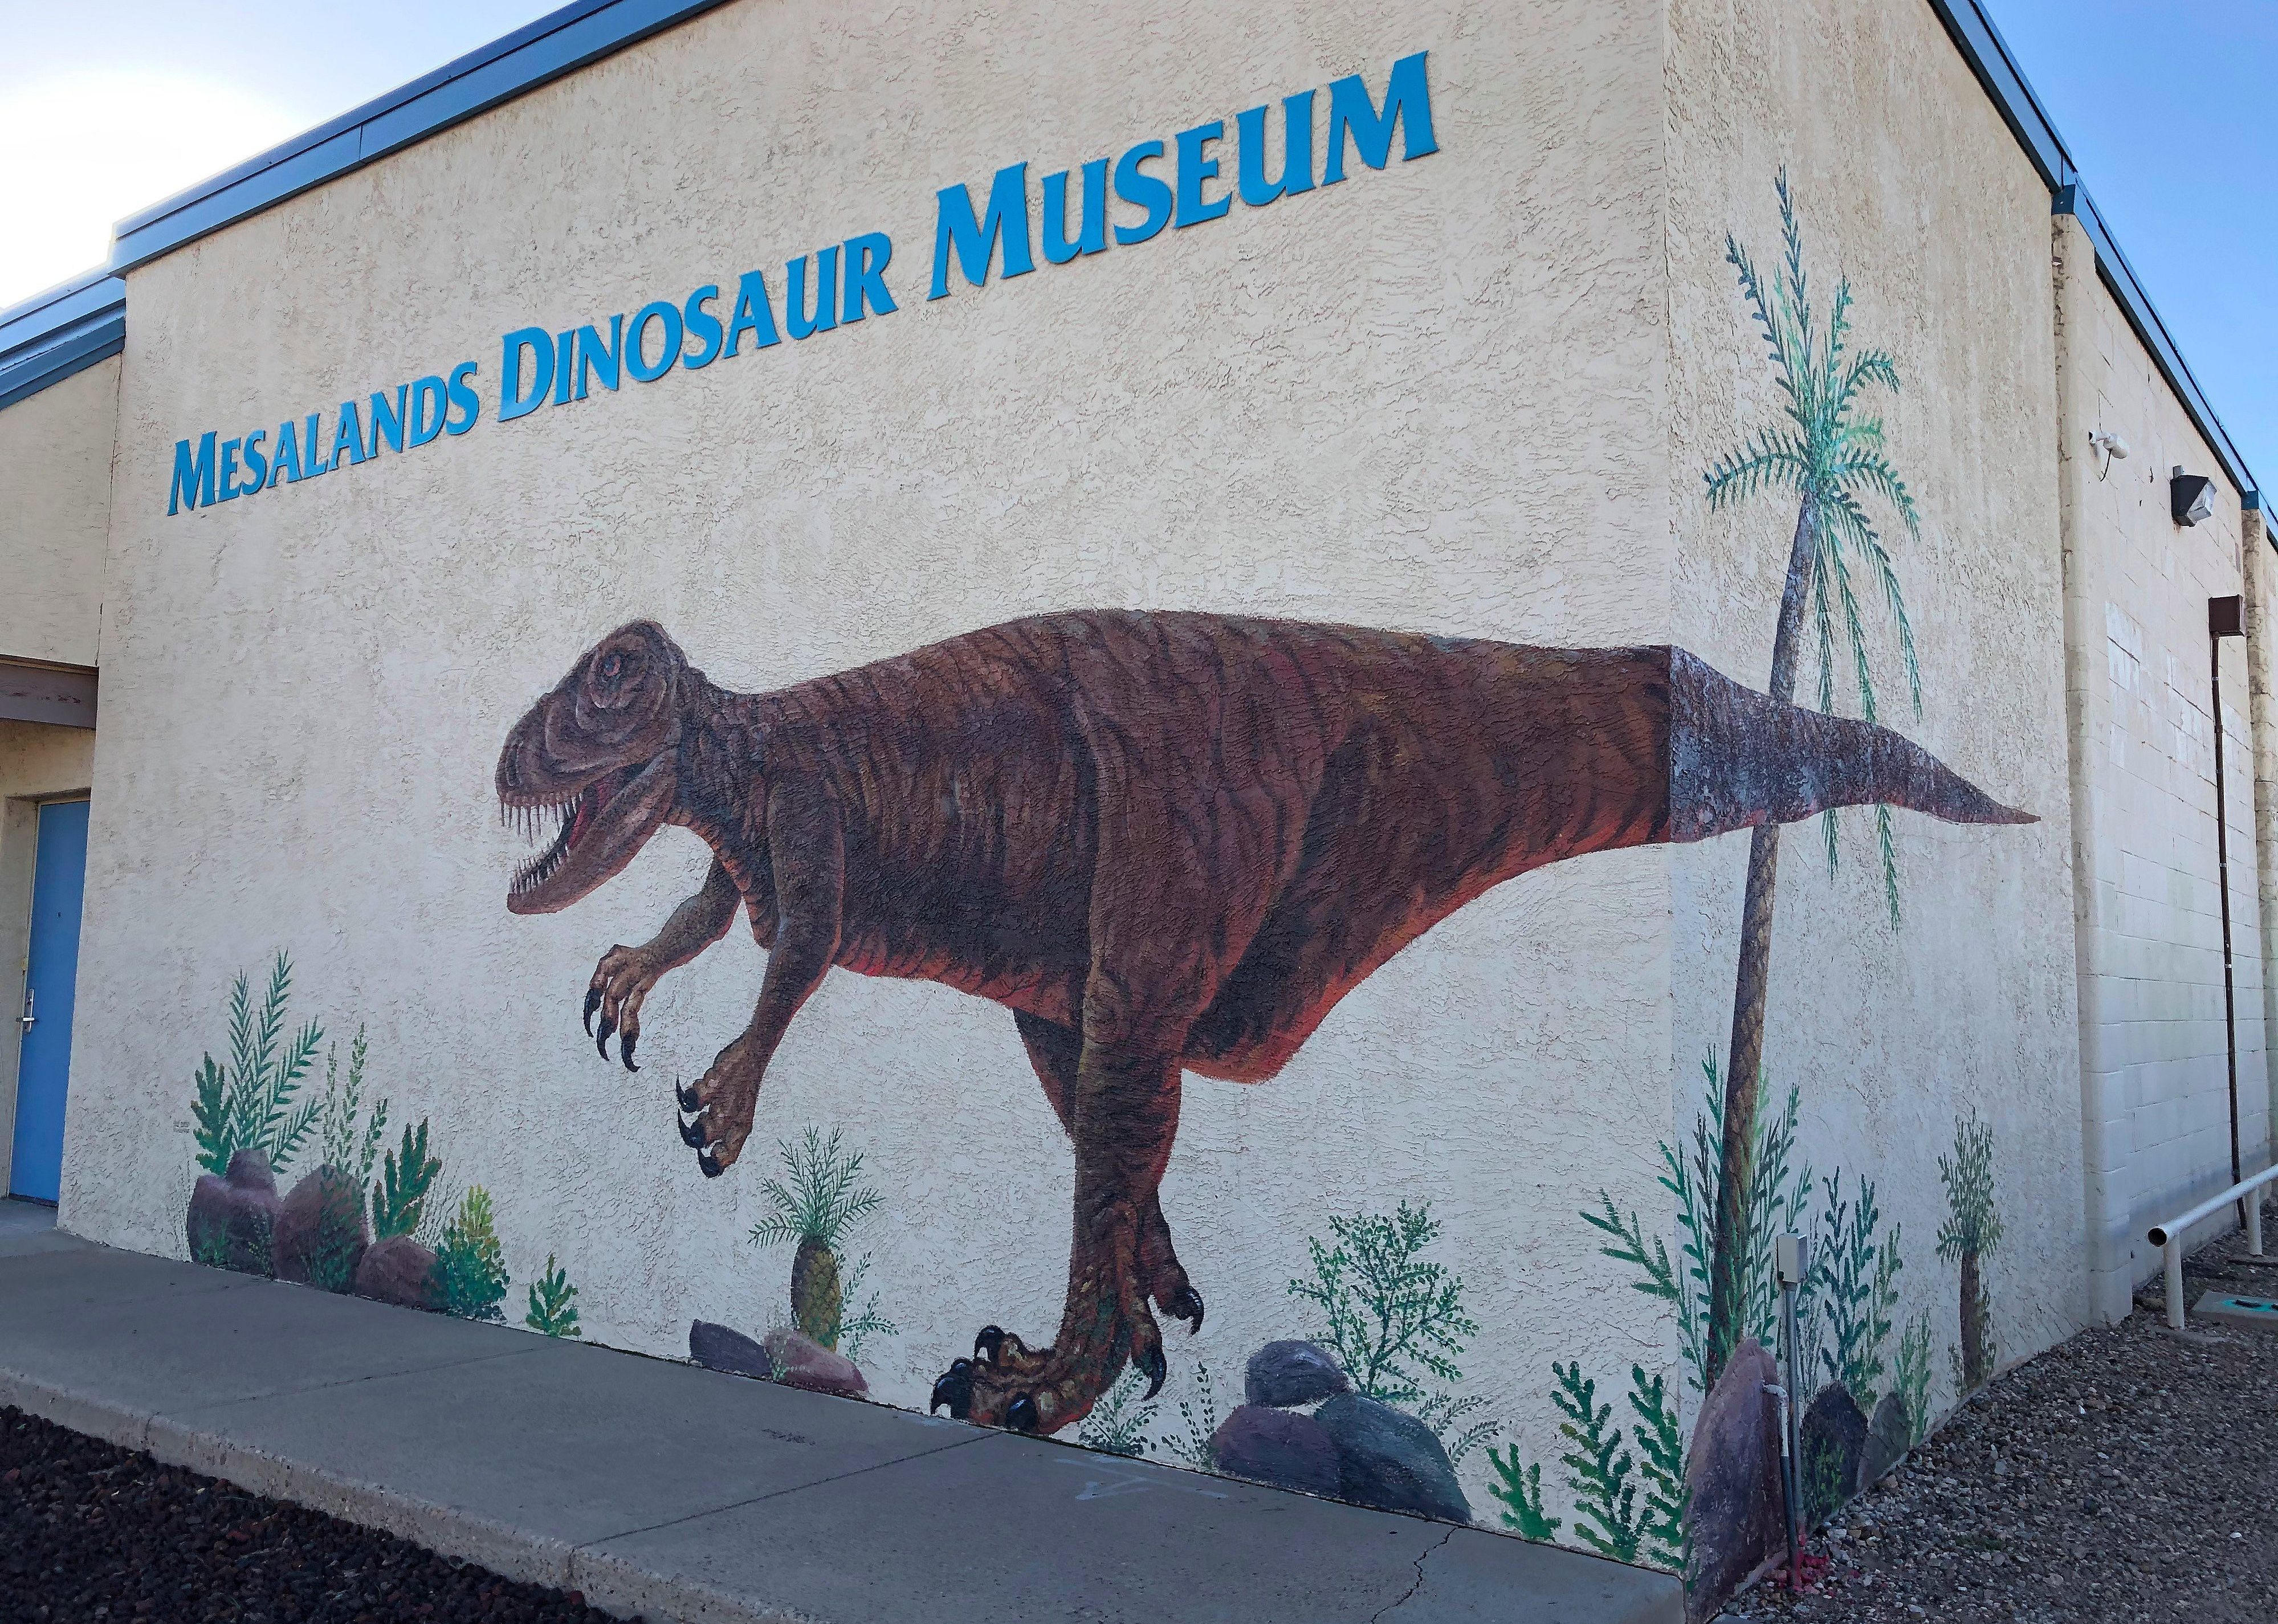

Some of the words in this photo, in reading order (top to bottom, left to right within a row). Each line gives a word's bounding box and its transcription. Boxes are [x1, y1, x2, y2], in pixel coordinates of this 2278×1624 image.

[167, 361, 480, 516] MESALANDS
[498, 231, 898, 422] DINOSAUR
[927, 50, 1440, 301] MUSEUM
